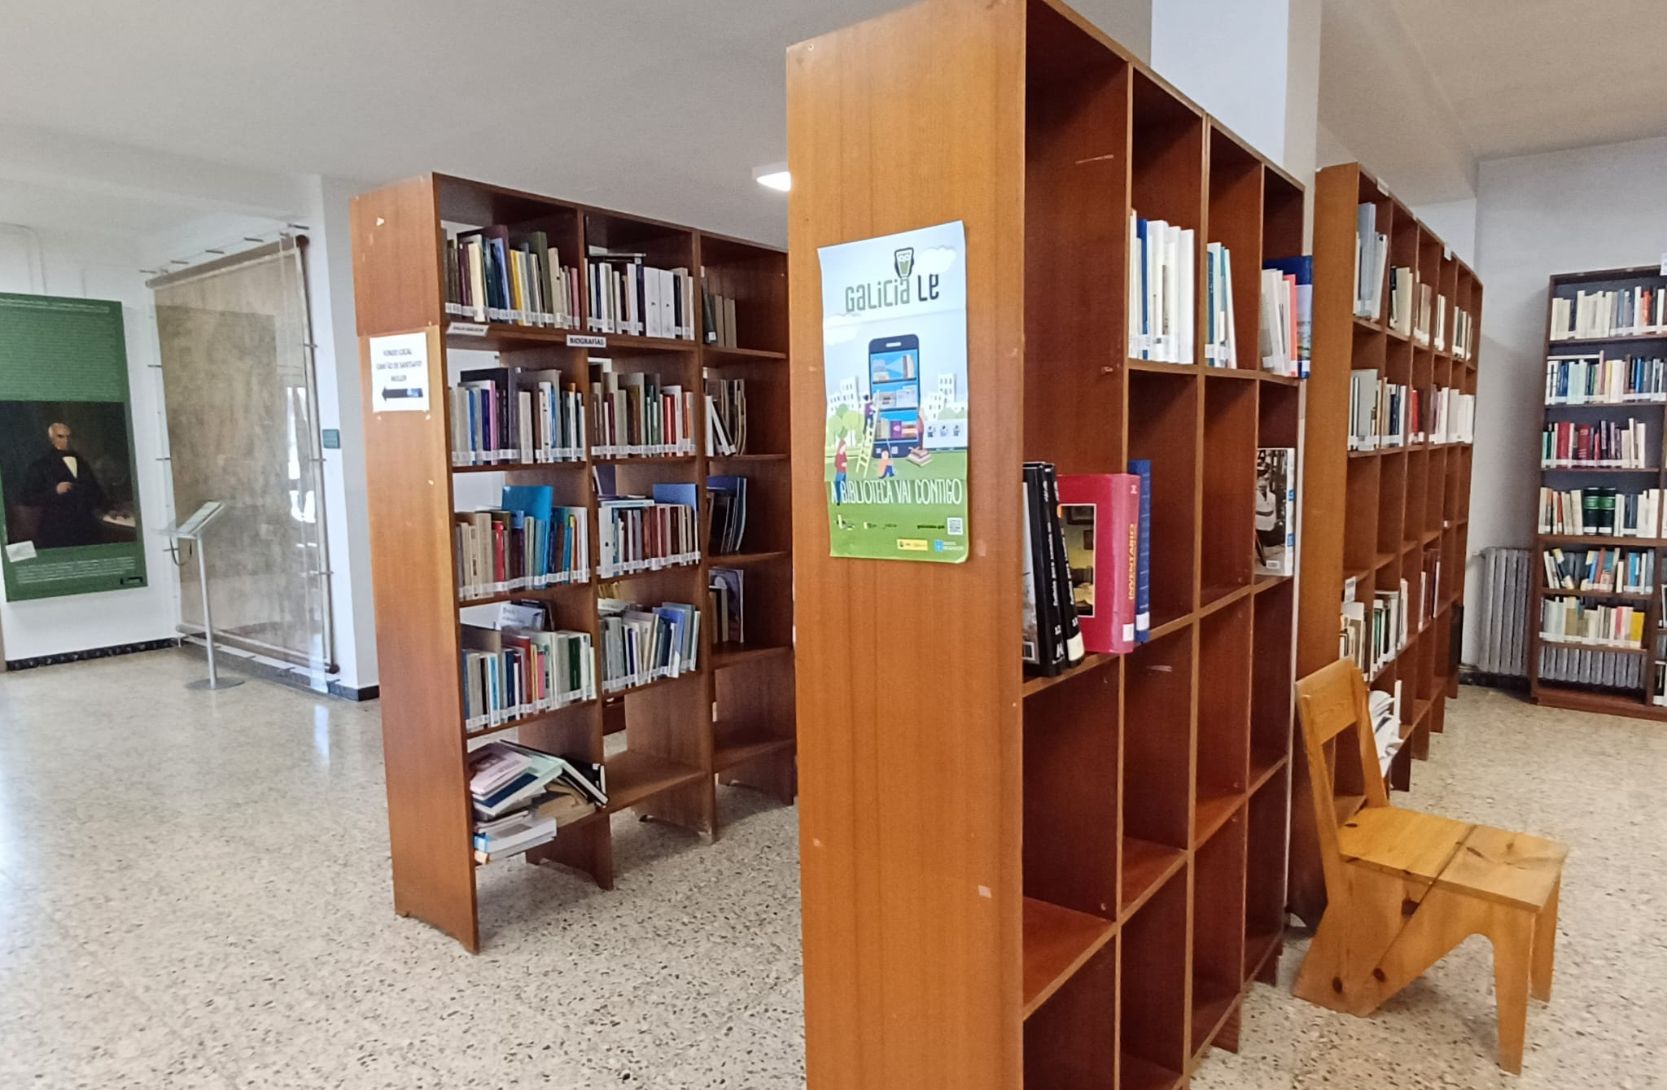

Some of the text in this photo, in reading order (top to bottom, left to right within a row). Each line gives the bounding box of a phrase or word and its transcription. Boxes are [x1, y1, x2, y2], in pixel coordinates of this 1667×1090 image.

[840, 479, 894, 504] BIBLIOTECA
[894, 479, 911, 504] VAI
[914, 478, 962, 505] CONTIGO
